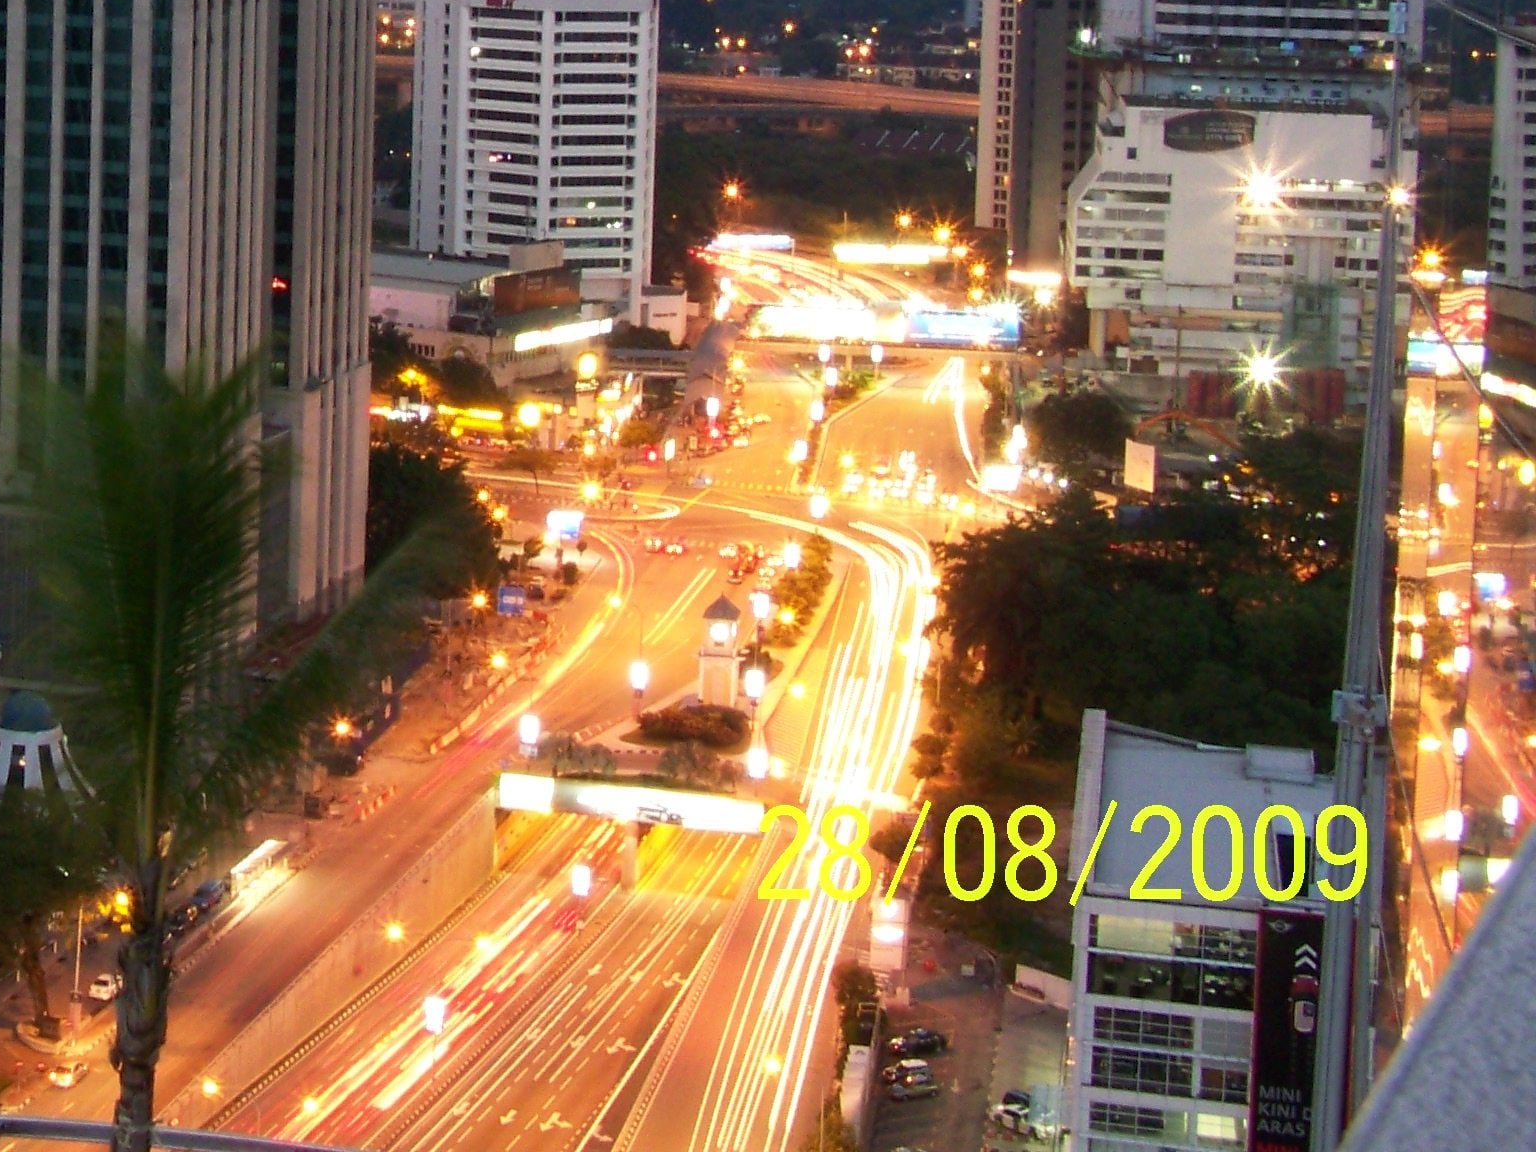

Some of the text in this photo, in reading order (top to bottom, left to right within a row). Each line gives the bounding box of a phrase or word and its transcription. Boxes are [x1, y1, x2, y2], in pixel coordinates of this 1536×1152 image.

[1259, 1085, 1301, 1103] MINI
[1258, 1102, 1296, 1119] KINI
[1257, 1119, 1306, 1136] ARAS
